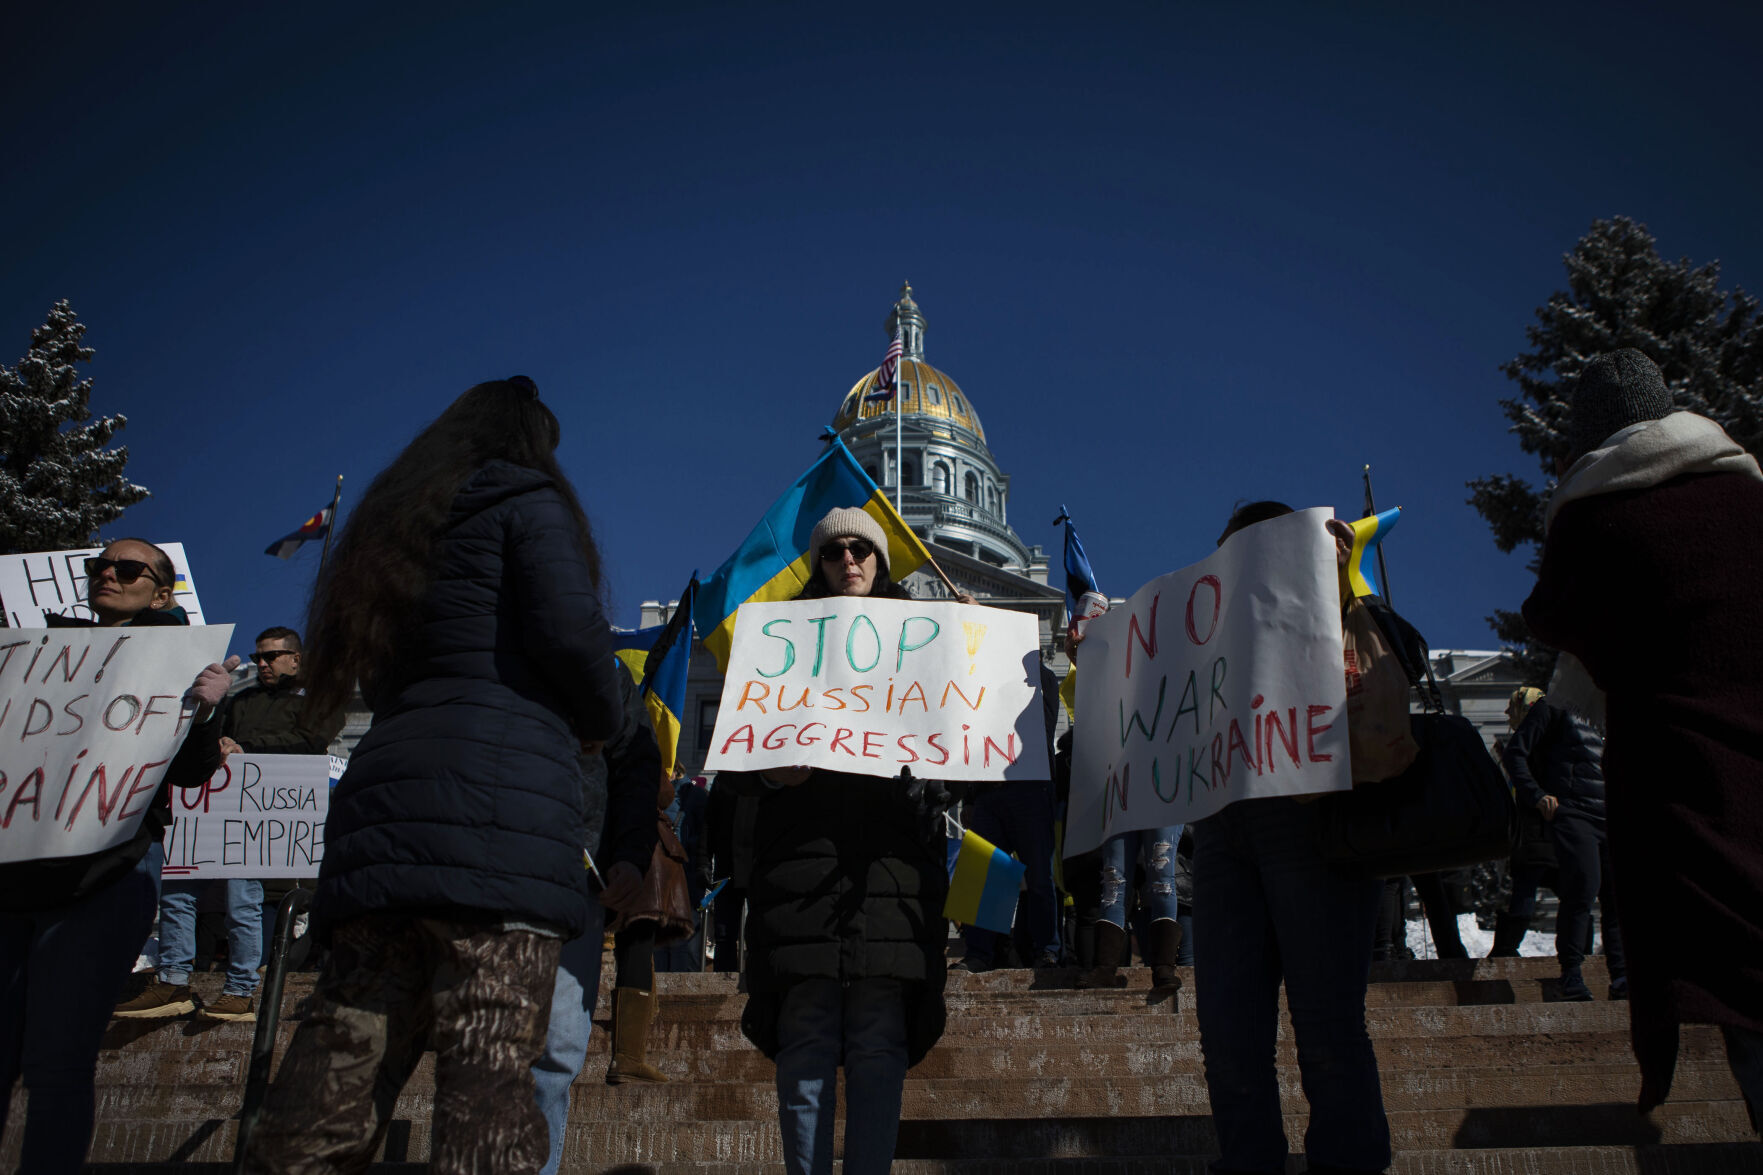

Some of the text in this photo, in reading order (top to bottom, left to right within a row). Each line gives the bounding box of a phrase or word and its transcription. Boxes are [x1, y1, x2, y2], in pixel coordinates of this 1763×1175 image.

[22, 553, 91, 606] HE
[1125, 574, 1222, 679] NO
[0, 694, 89, 742] DS
[1119, 656, 1228, 748] WAR
[720, 721, 1018, 769] AGGRESSIN
[162, 816, 326, 867] VIL EMPIRE
